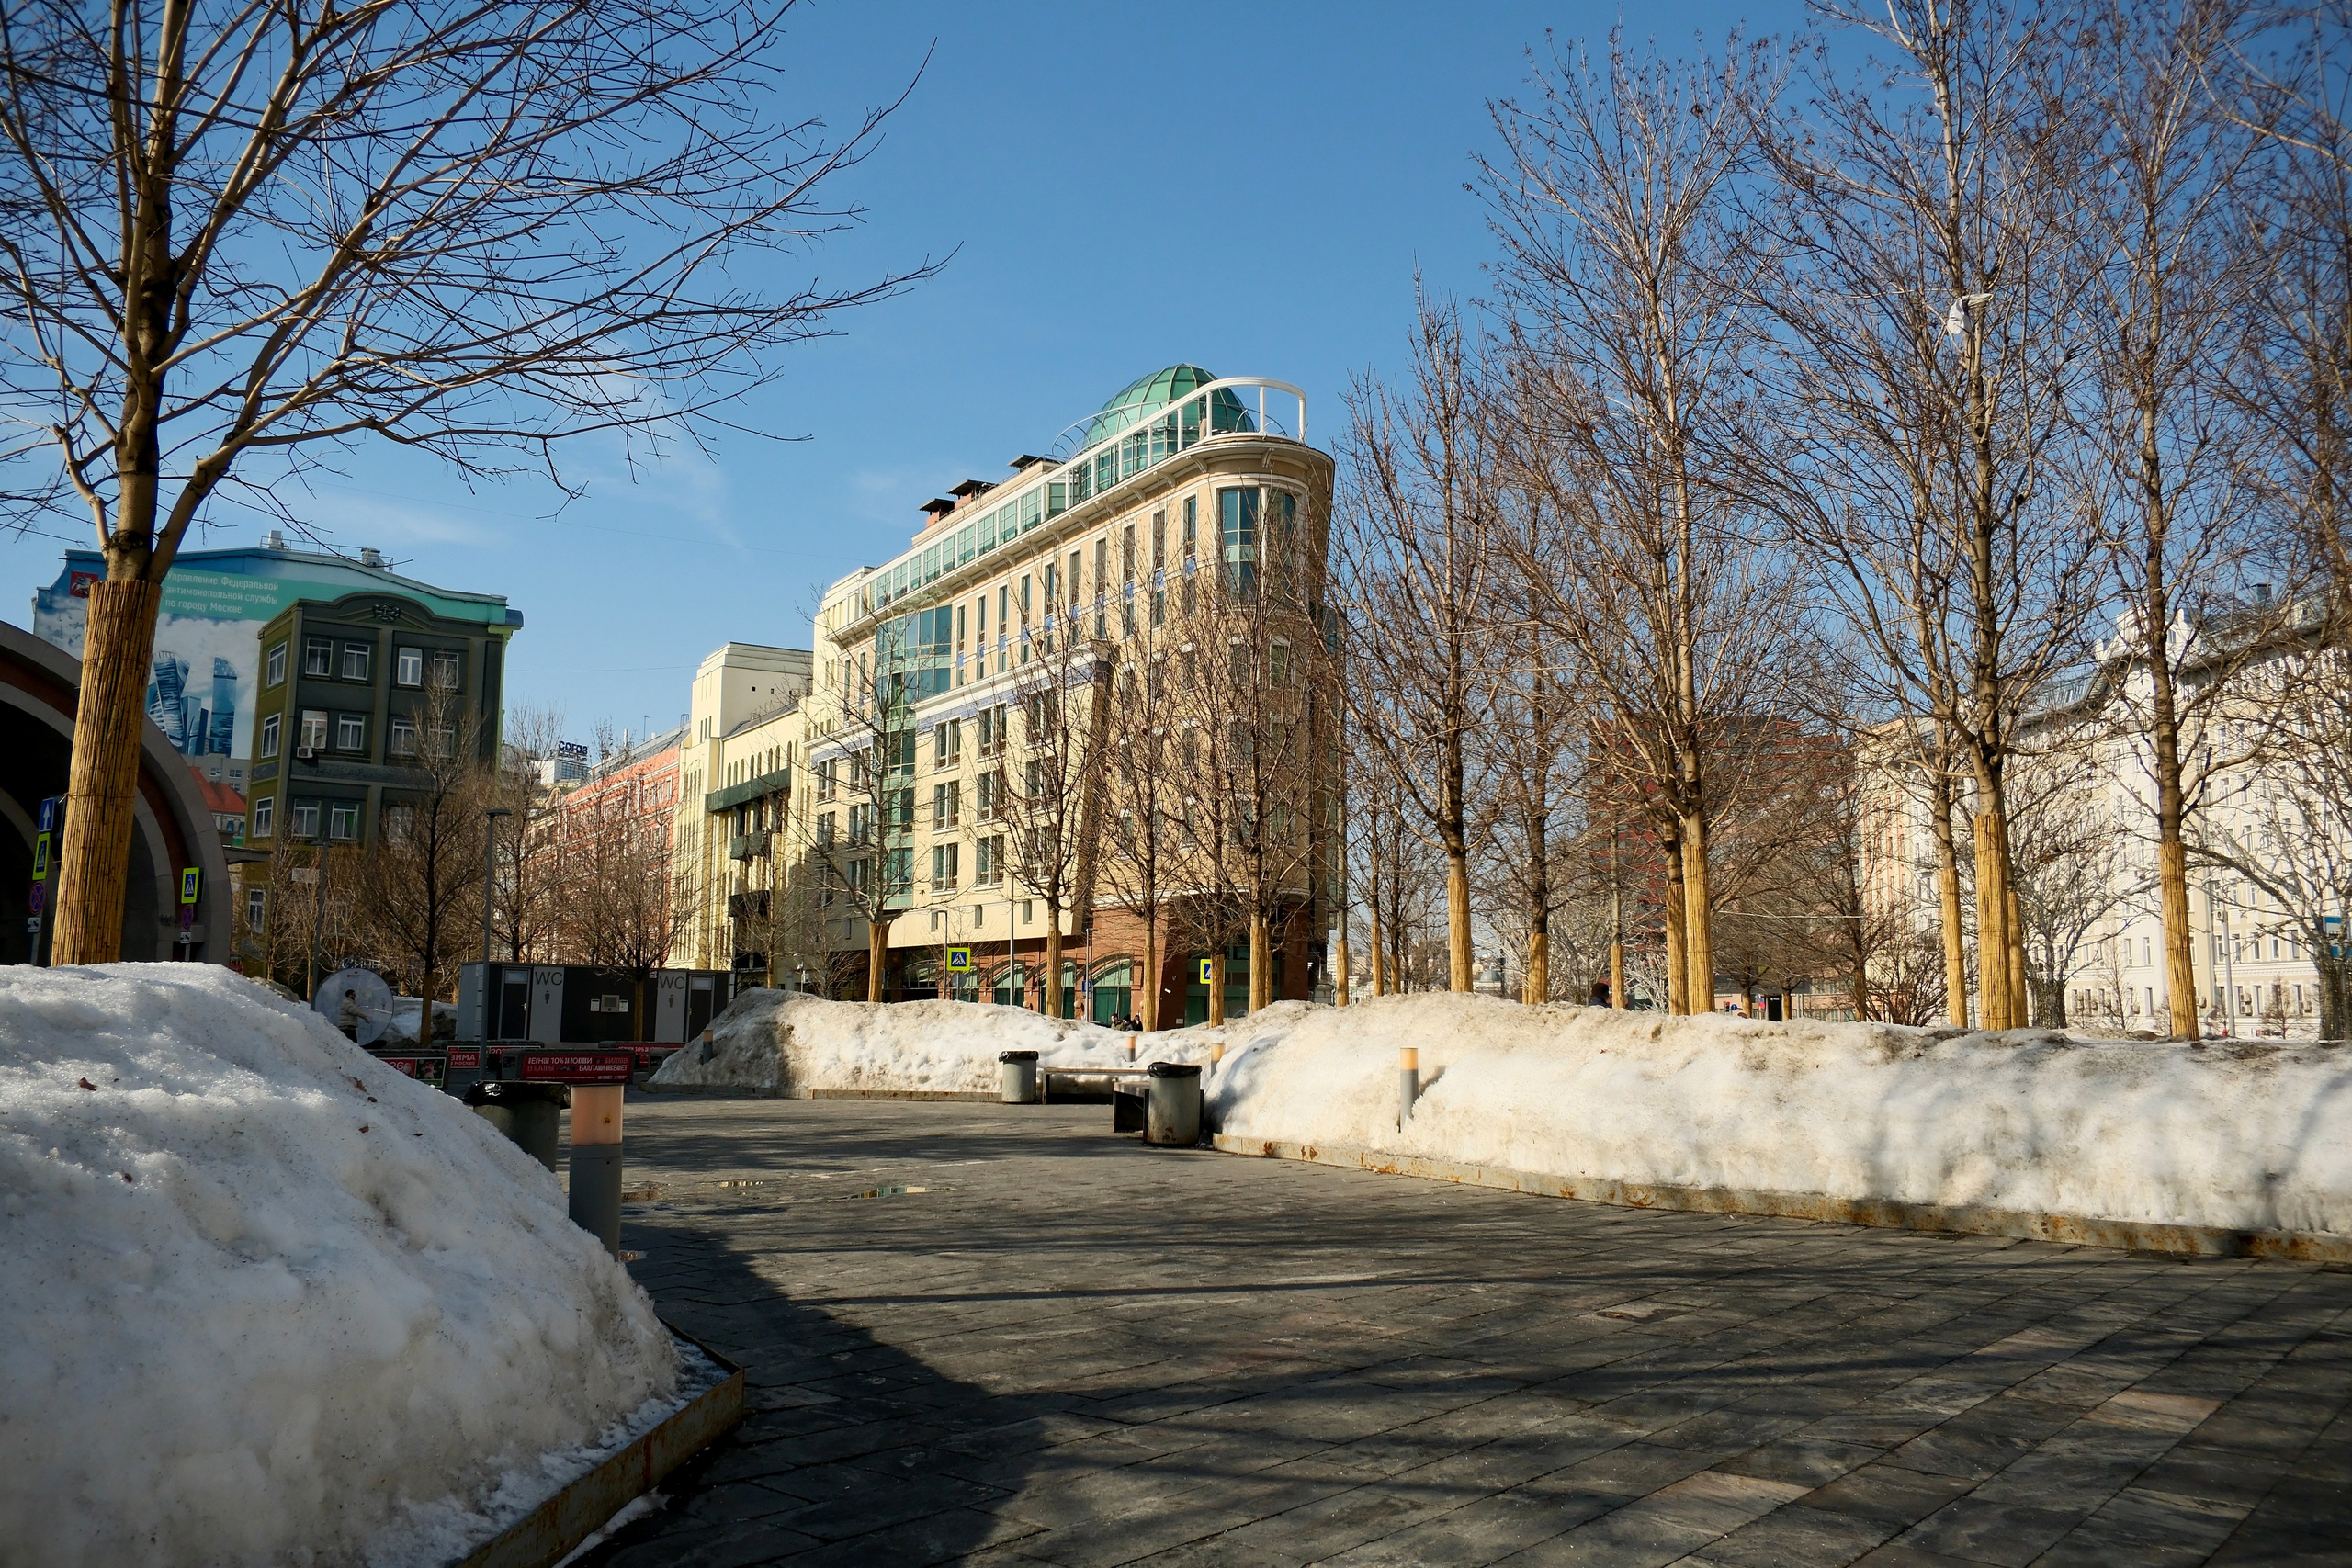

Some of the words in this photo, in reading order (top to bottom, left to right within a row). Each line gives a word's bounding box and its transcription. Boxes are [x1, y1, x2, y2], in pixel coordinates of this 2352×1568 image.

[167, 571, 219, 585] Управление
[221, 577, 278, 591] Федеральной
[166, 586, 243, 601] антимонопольной
[244, 593, 278, 604] службы
[178, 601, 208, 613] городу
[209, 602, 242, 614] Москве
[535, 971, 563, 986] WC
[660, 976, 685, 990] WC
